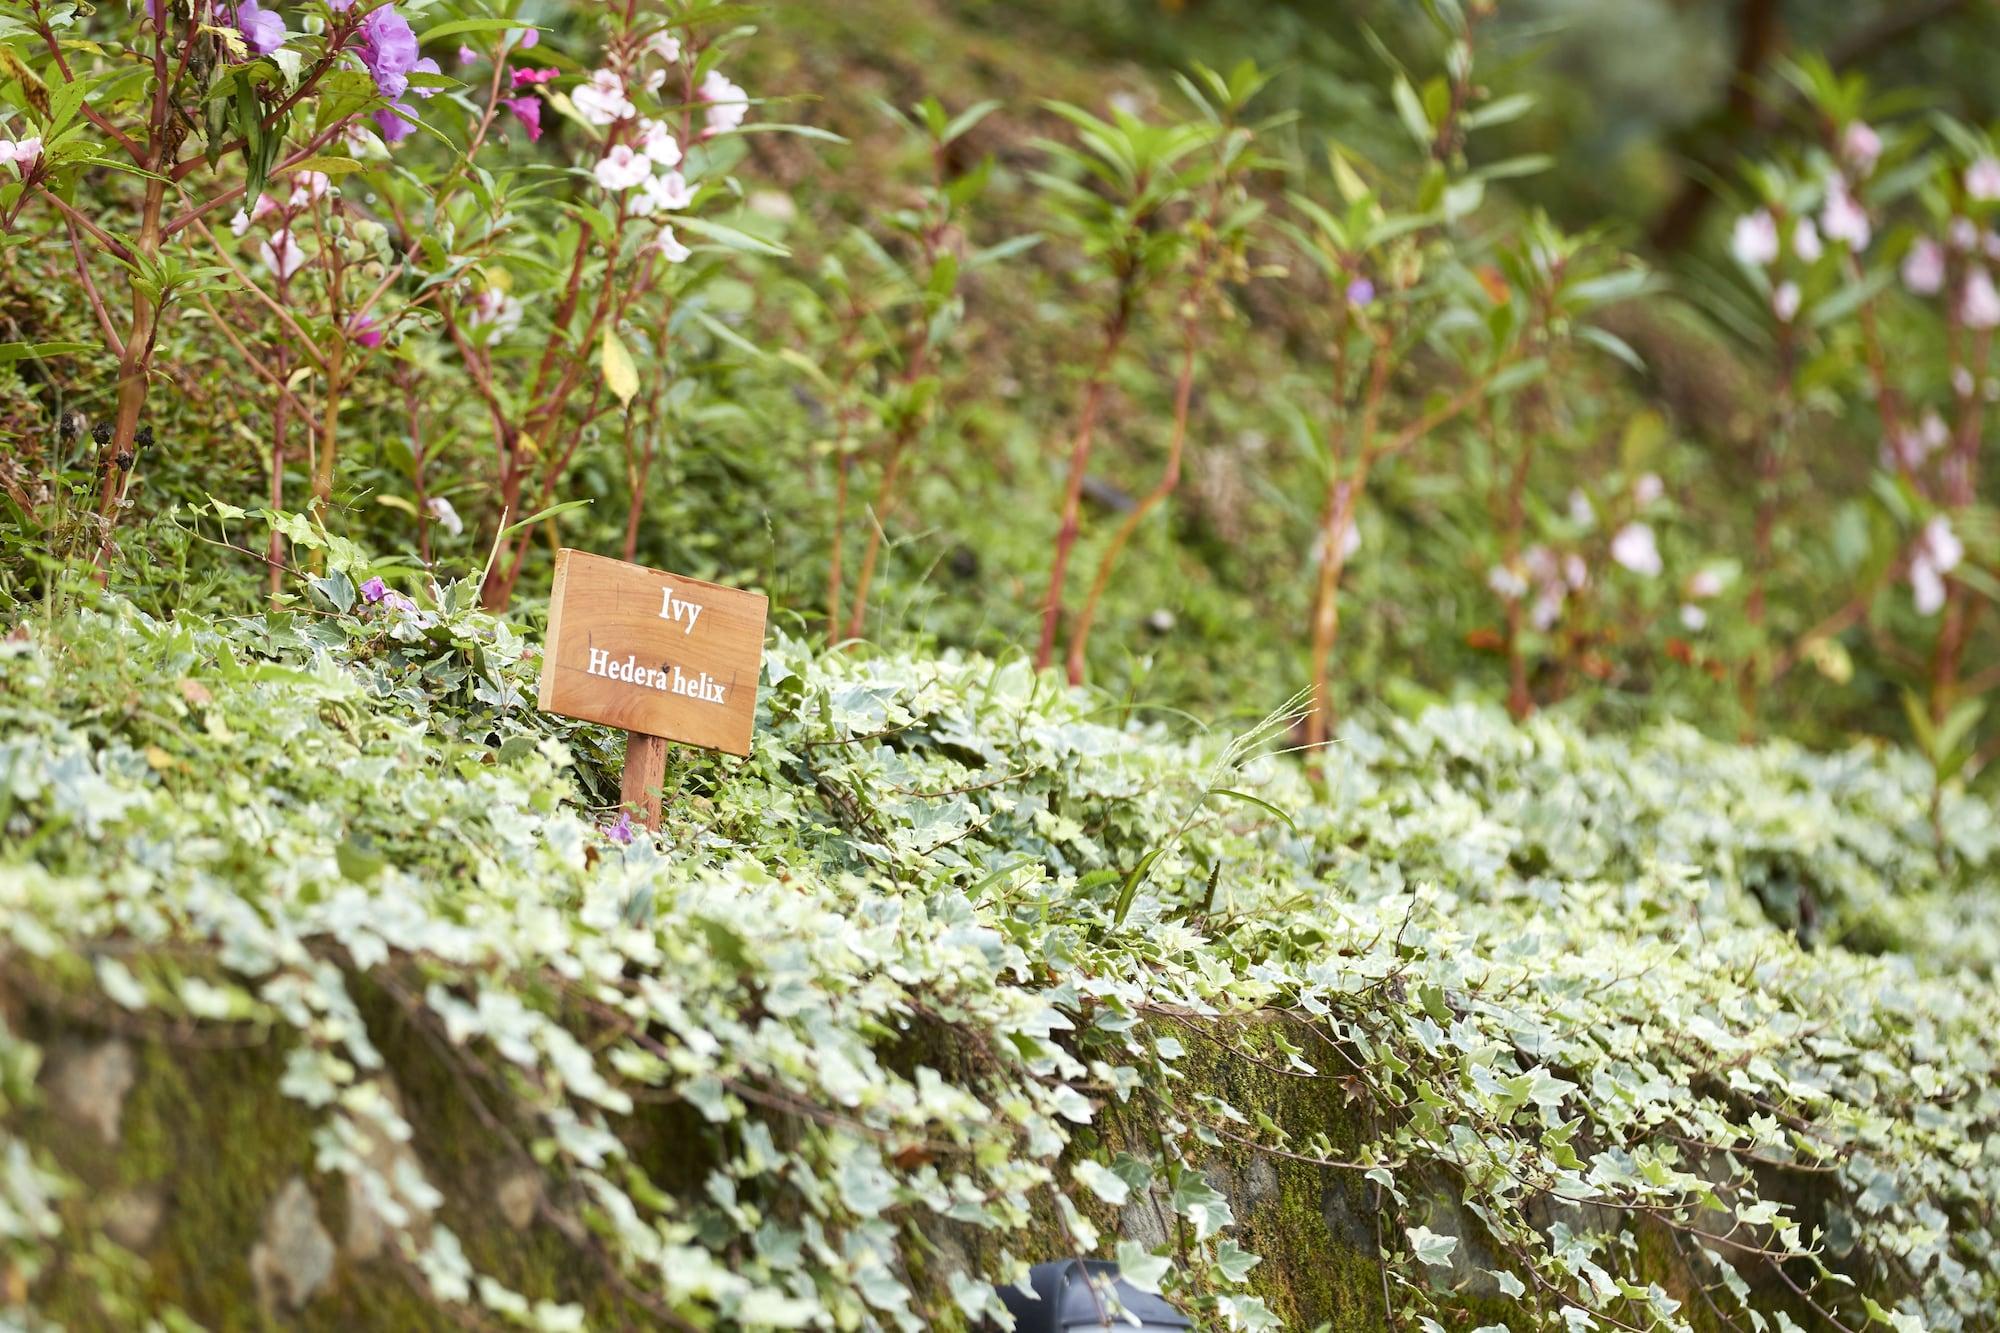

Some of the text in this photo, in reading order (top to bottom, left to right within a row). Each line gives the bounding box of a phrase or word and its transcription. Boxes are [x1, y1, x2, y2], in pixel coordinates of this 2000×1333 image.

[658, 586, 703, 635] Ivy
[586, 647, 726, 704] Hedera helix
